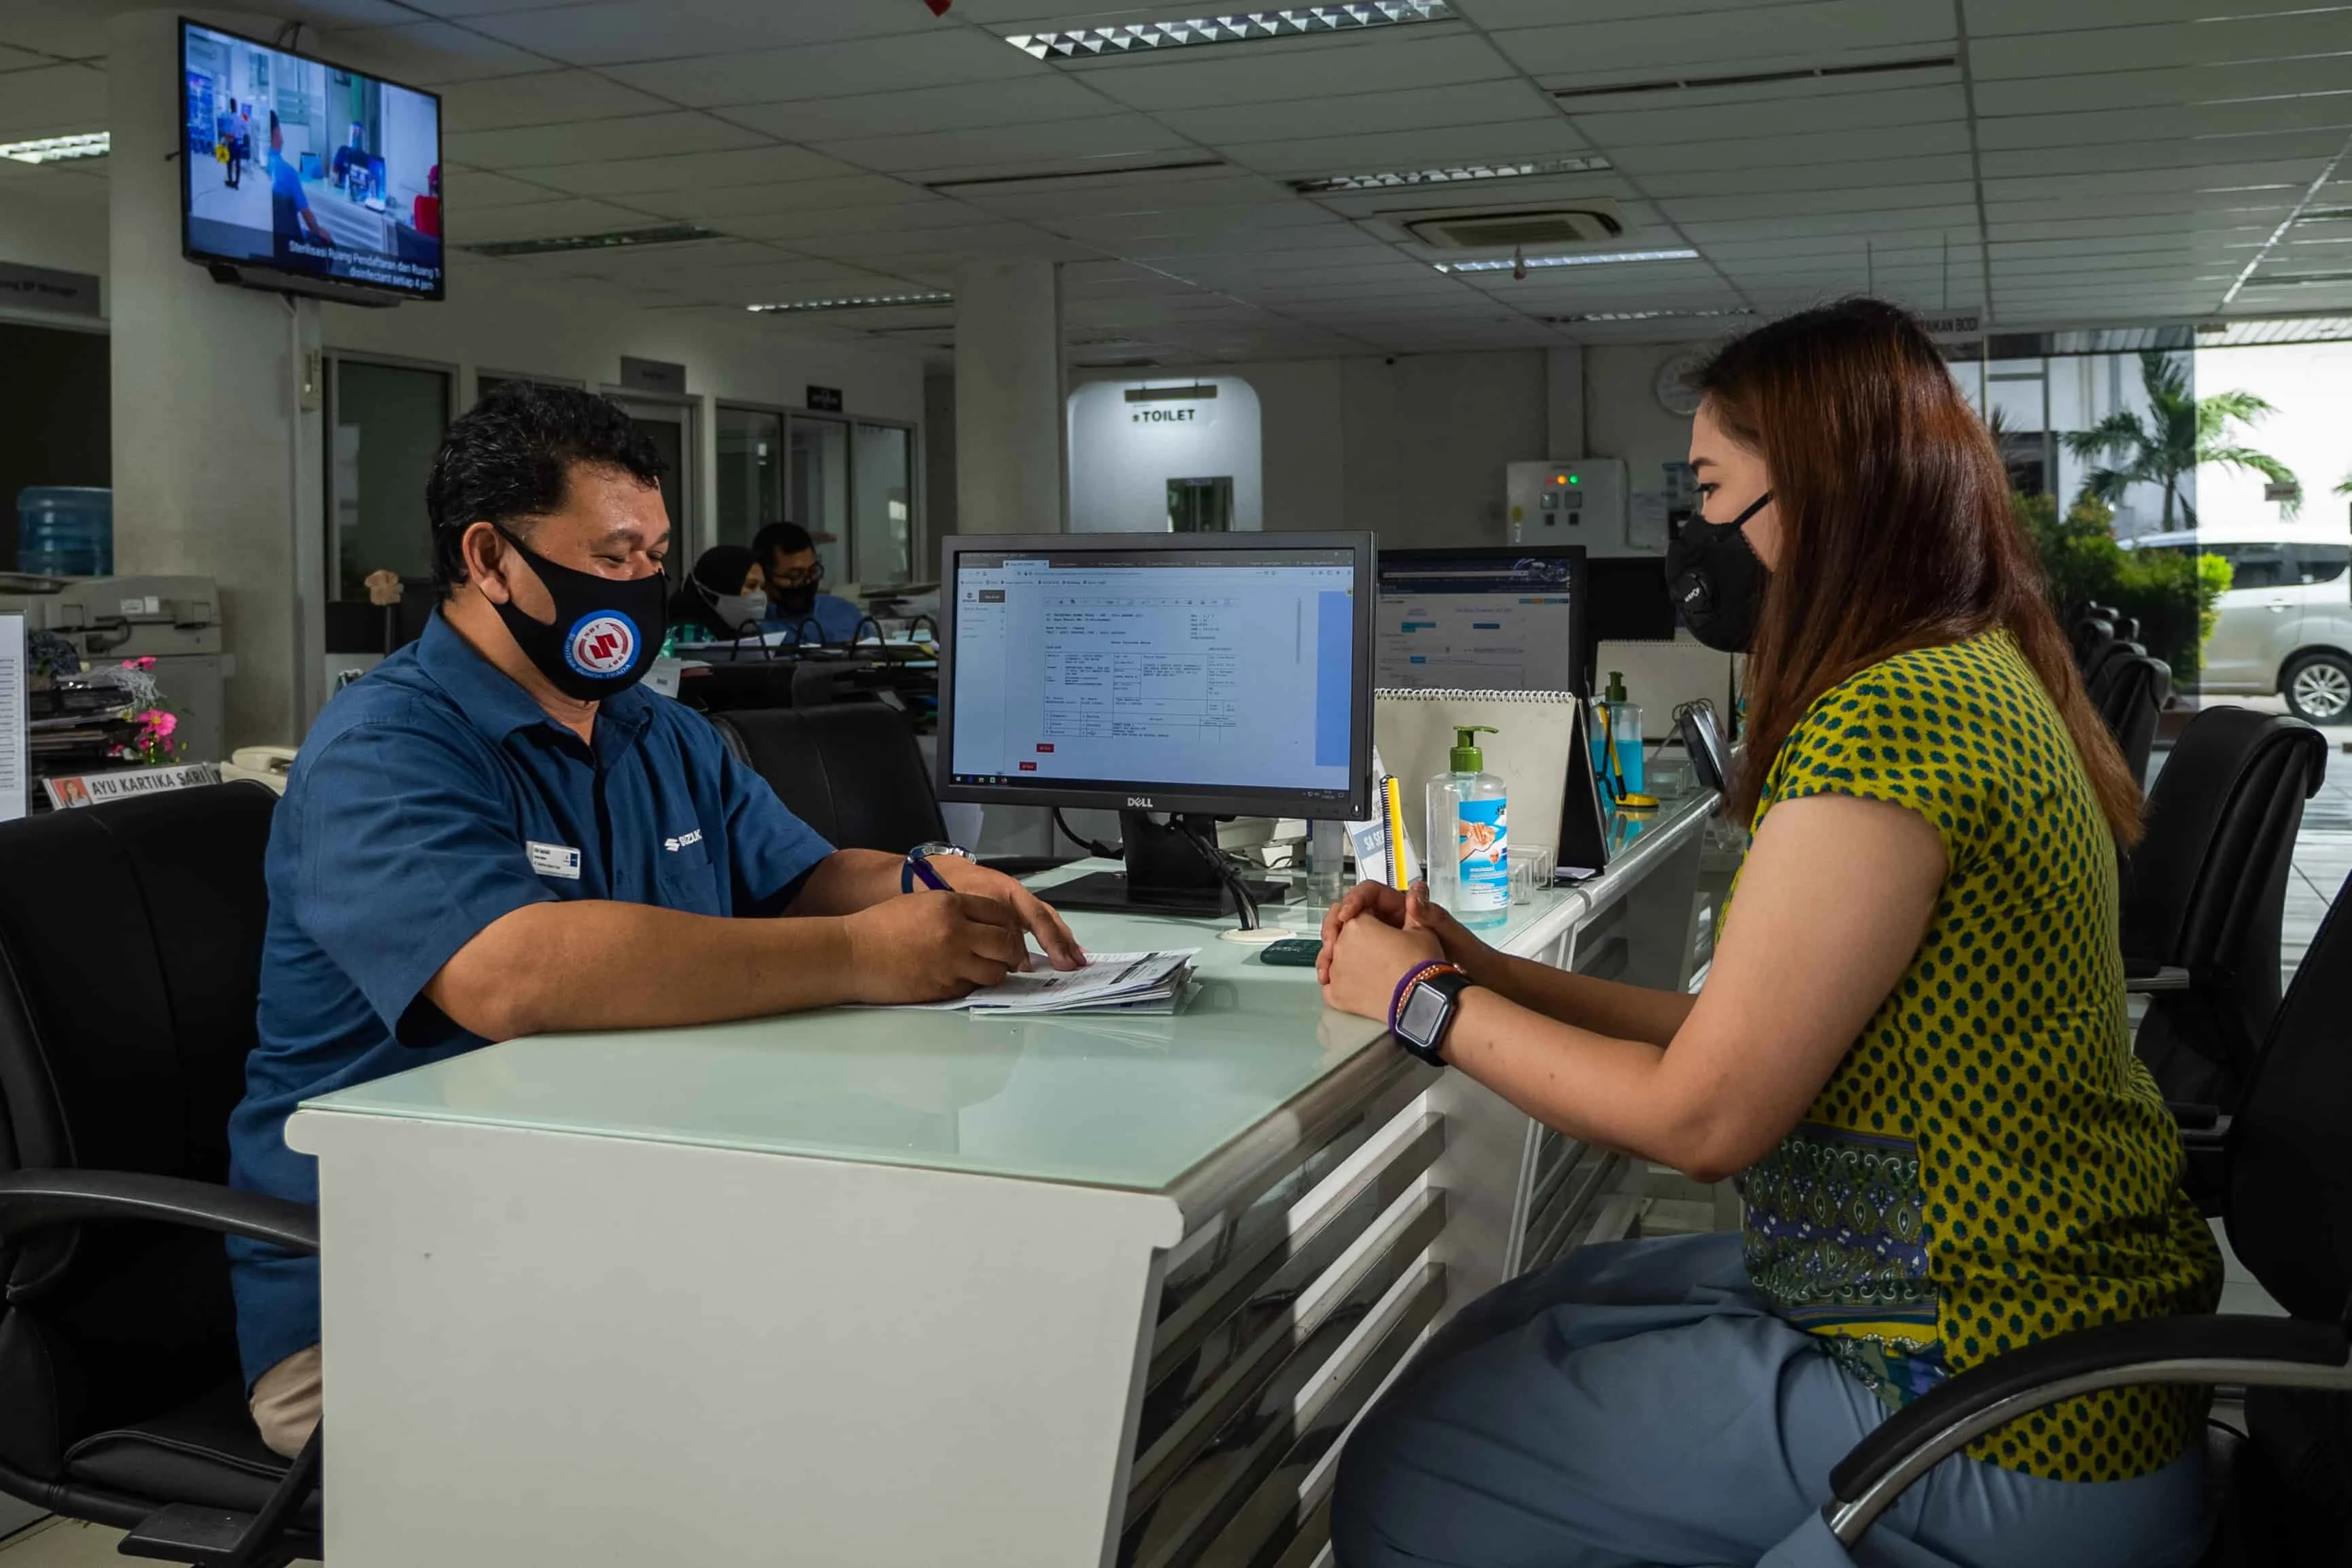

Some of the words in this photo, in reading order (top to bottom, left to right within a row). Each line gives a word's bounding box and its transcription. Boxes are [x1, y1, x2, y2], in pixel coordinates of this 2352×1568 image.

[1142, 409, 1195, 423] TOILET
[91, 778, 118, 795] AYU
[119, 773, 175, 792] KARTIKA
[1127, 797, 1154, 808] DELL
